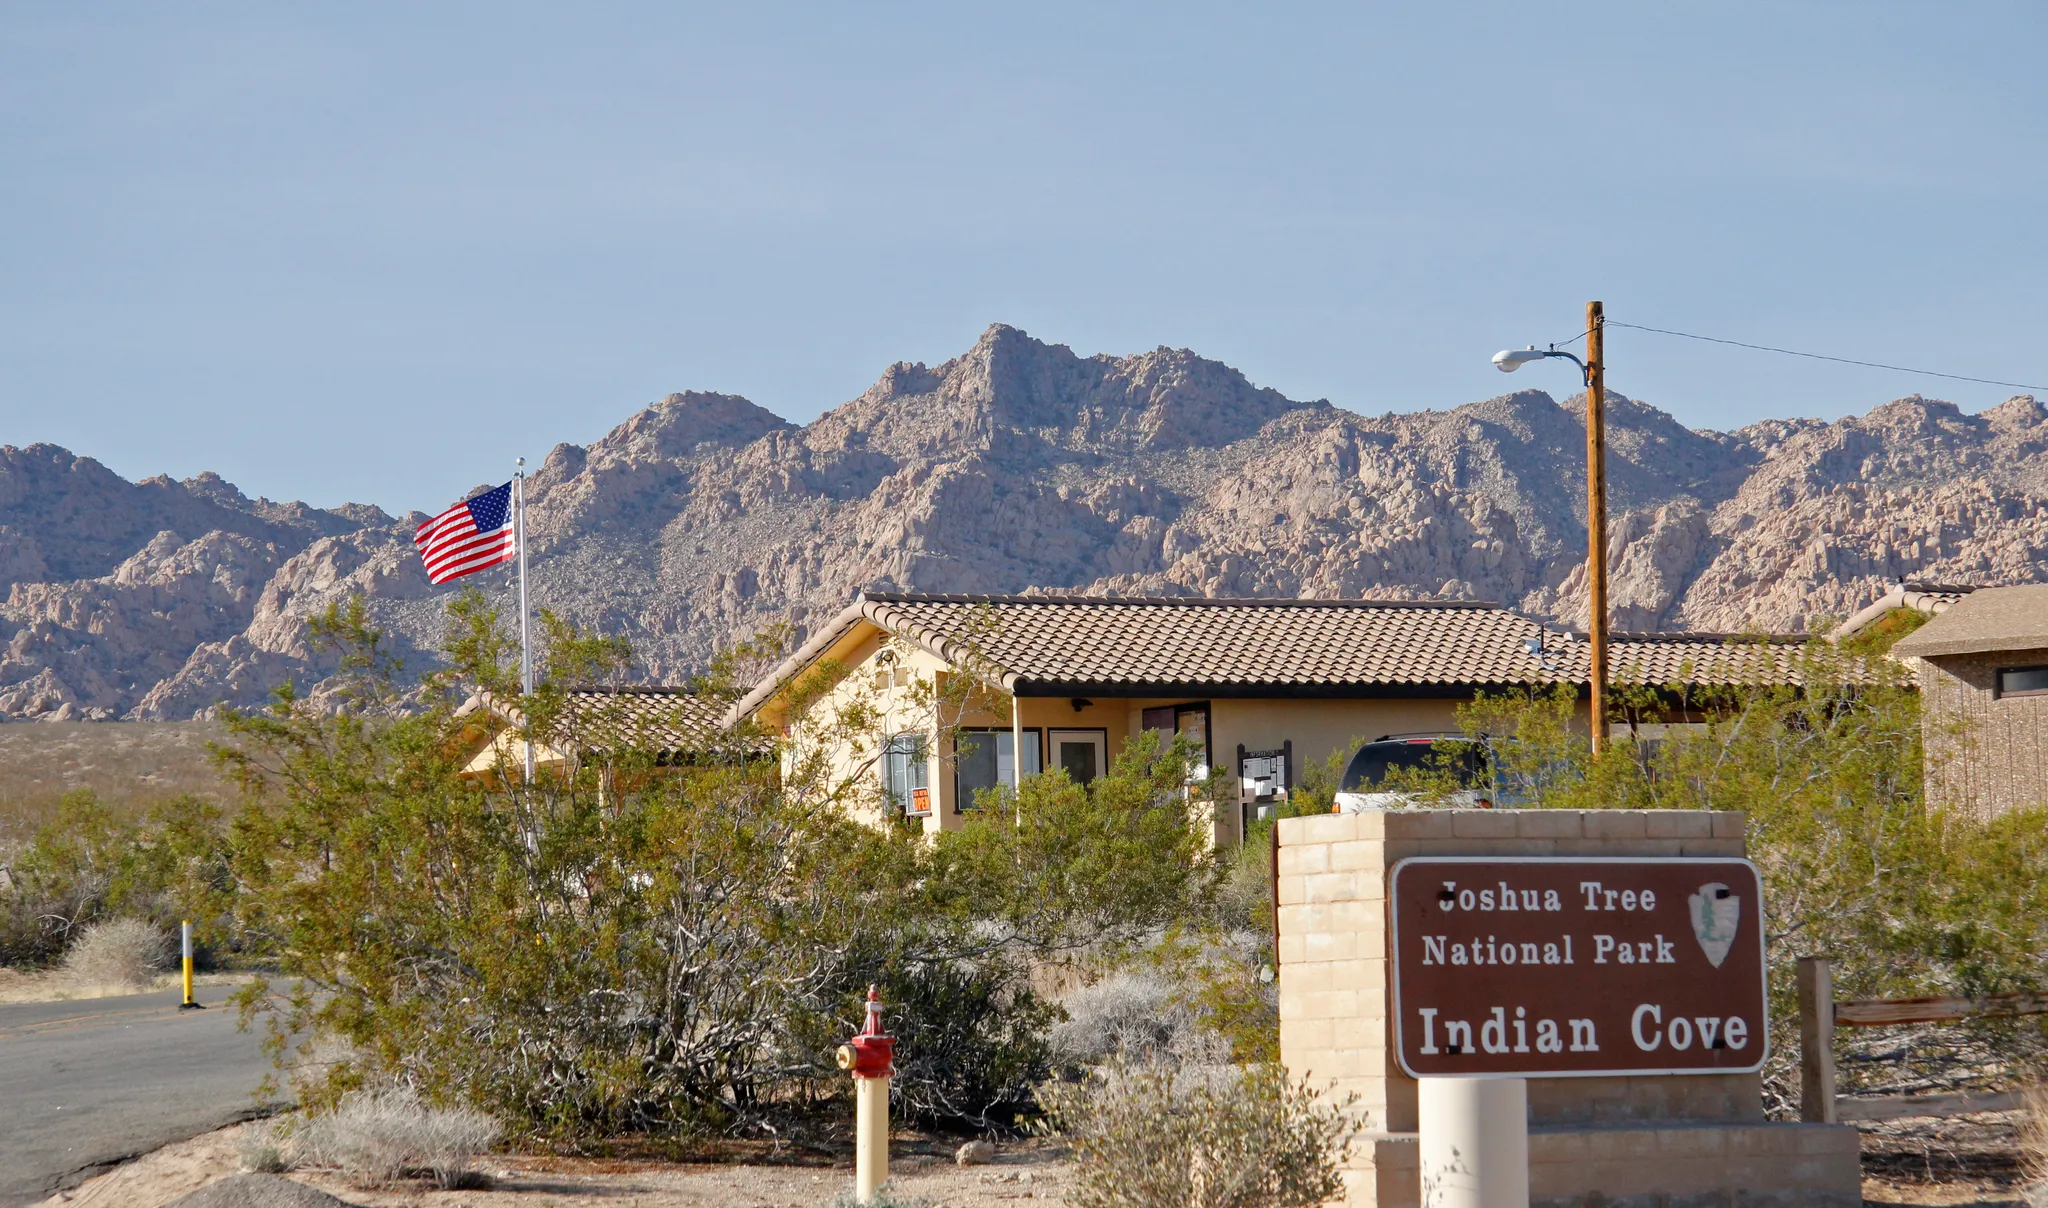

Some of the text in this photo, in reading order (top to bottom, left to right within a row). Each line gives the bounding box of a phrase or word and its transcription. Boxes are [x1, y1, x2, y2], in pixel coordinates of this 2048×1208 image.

[1439, 881, 1655, 911] Joshua Tree
[1422, 935, 1676, 965] National Park
[1419, 1004, 1747, 1054] Indian Cove
